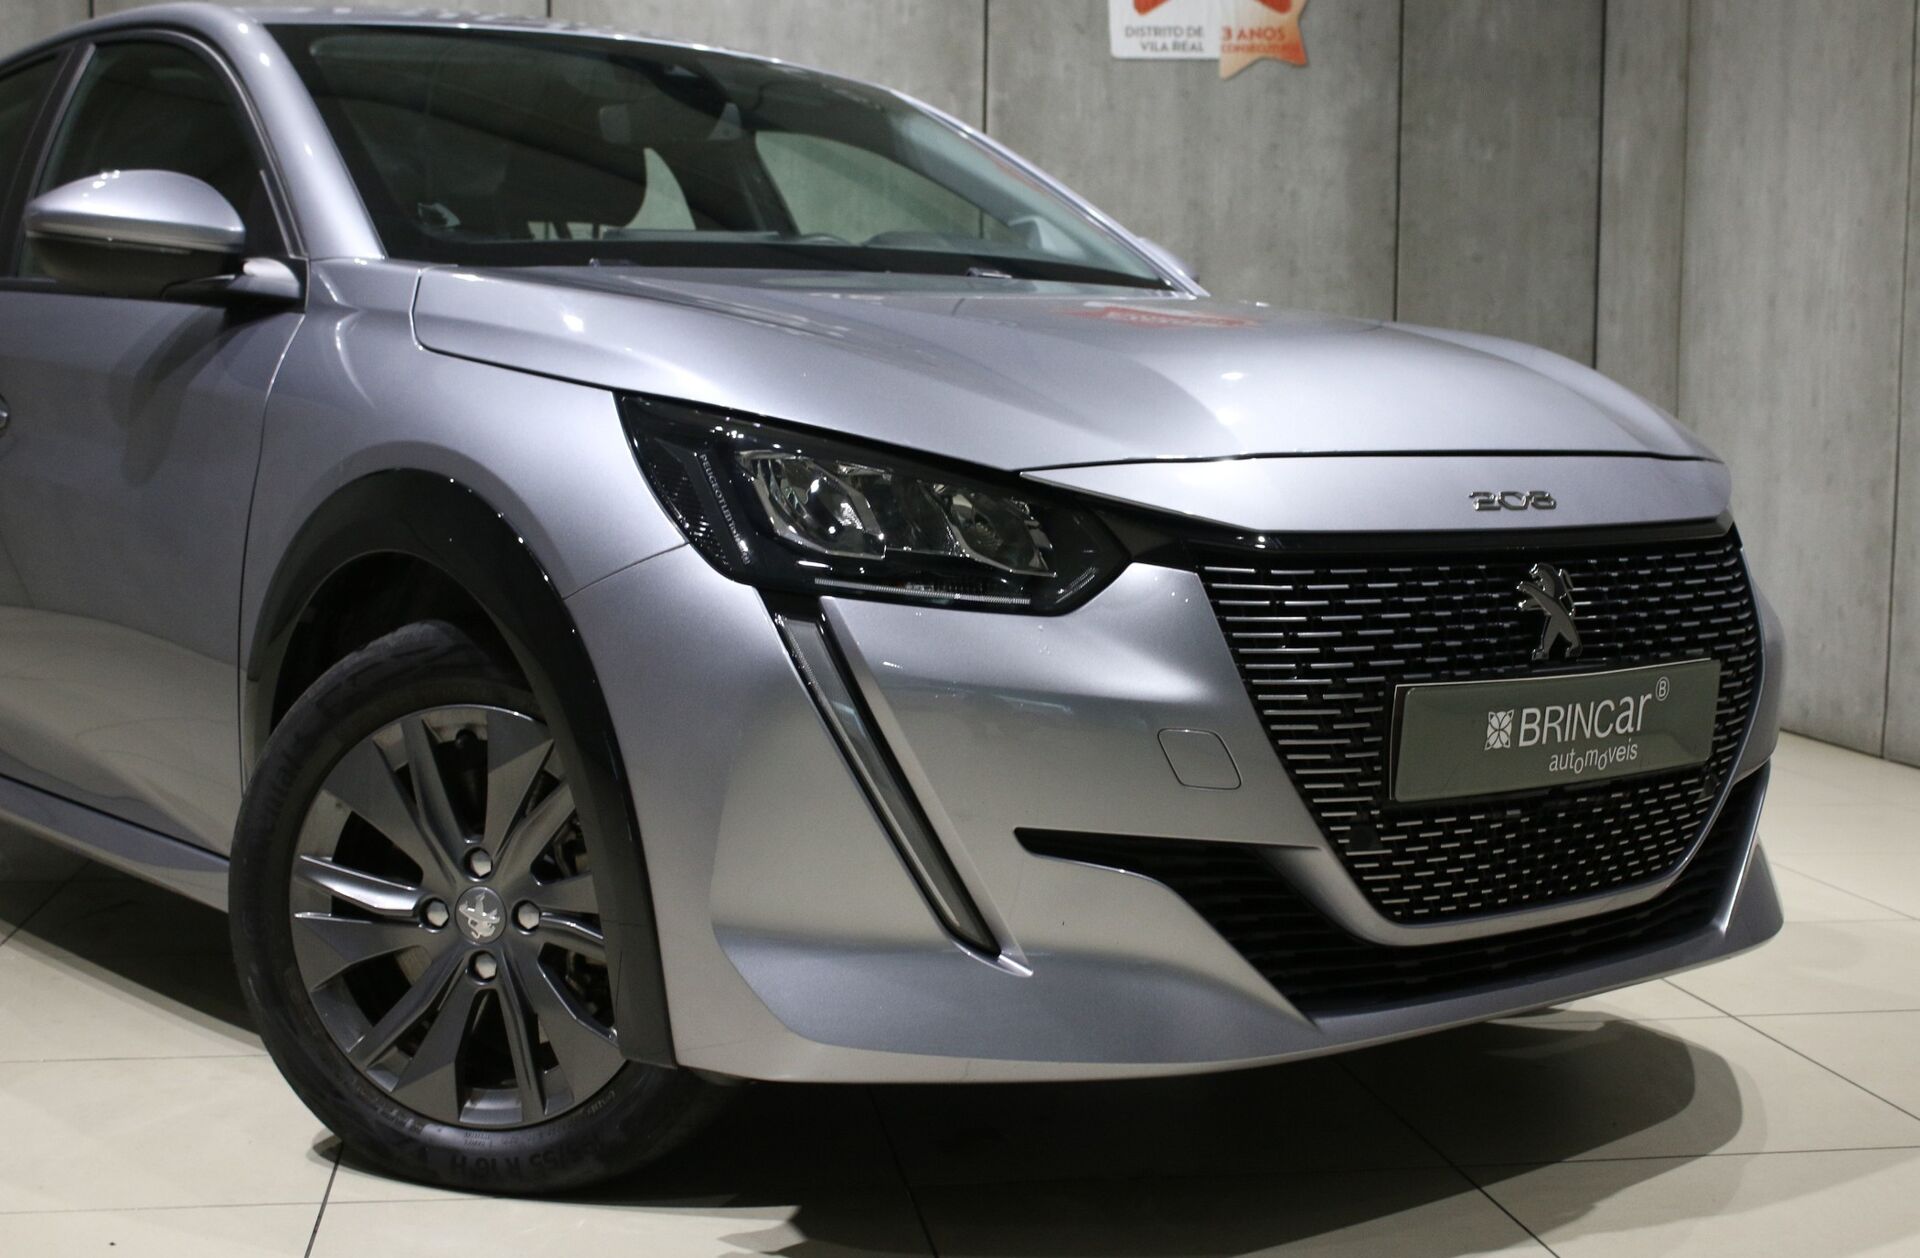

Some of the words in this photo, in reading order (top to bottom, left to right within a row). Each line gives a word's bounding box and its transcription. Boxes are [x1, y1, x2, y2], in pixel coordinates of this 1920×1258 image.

[1125, 25, 1184, 38] DISTRITO
[1186, 25, 1203, 38] DE
[1222, 26, 1232, 41] 3
[1236, 26, 1286, 41] ANOS
[1140, 40, 1169, 52] VILA
[1171, 40, 1204, 52] REAL
[700, 453, 725, 504] PEUGEOT
[1469, 490, 1557, 511] 208
[1518, 693, 1653, 748] BRINCar
